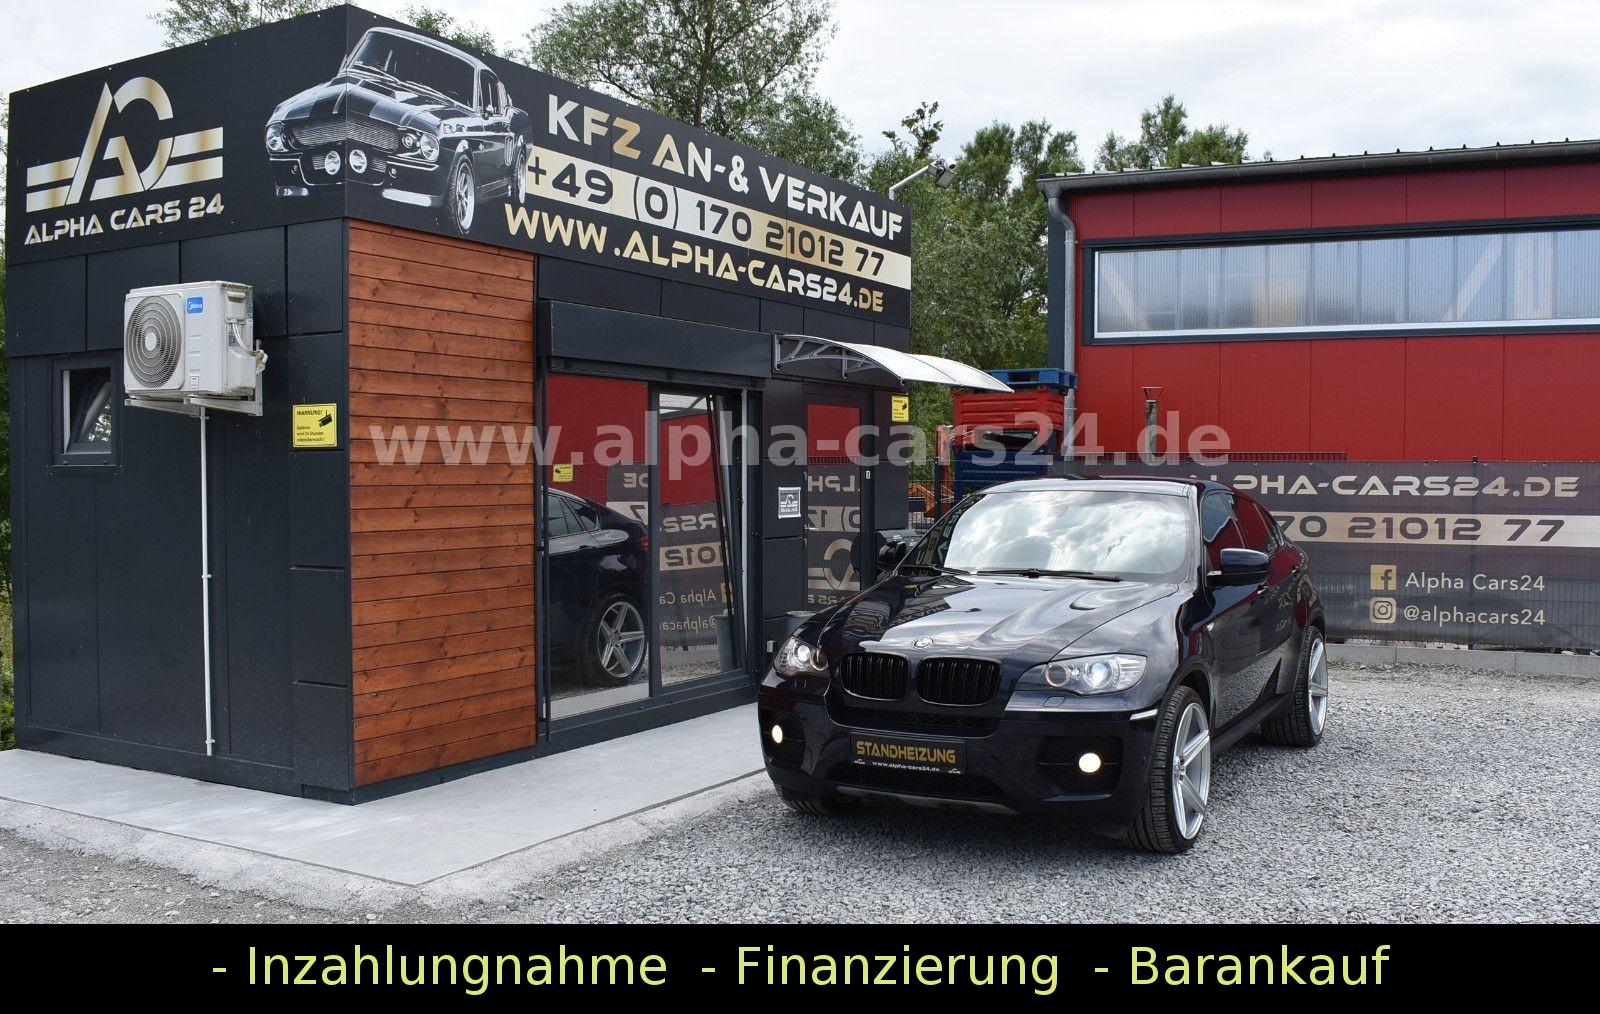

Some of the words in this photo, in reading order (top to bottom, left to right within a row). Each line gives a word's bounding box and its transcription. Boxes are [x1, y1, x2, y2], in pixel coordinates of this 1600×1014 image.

[549, 94, 641, 160] KFZ
[758, 165, 903, 240] VERKAUF
[24, 213, 103, 245] ALPHA
[110, 200, 181, 230] CARS
[188, 193, 224, 219] 24
[528, 155, 613, 205] +49
[633, 176, 679, 229] (0)
[696, 200, 752, 242] 170
[765, 220, 844, 266] 21012
[855, 246, 885, 277] 77
[1190, 474, 1580, 498] PHA-CARS24.DE
[1347, 517, 1482, 540] 21012
[1502, 518, 1565, 542] 77
[1405, 572, 1464, 593] Alpha
[1472, 573, 1546, 592] Cars24
[1403, 605, 1546, 627] @alphacars24
[856, 741, 956, 764] STANDHEIZUNG
